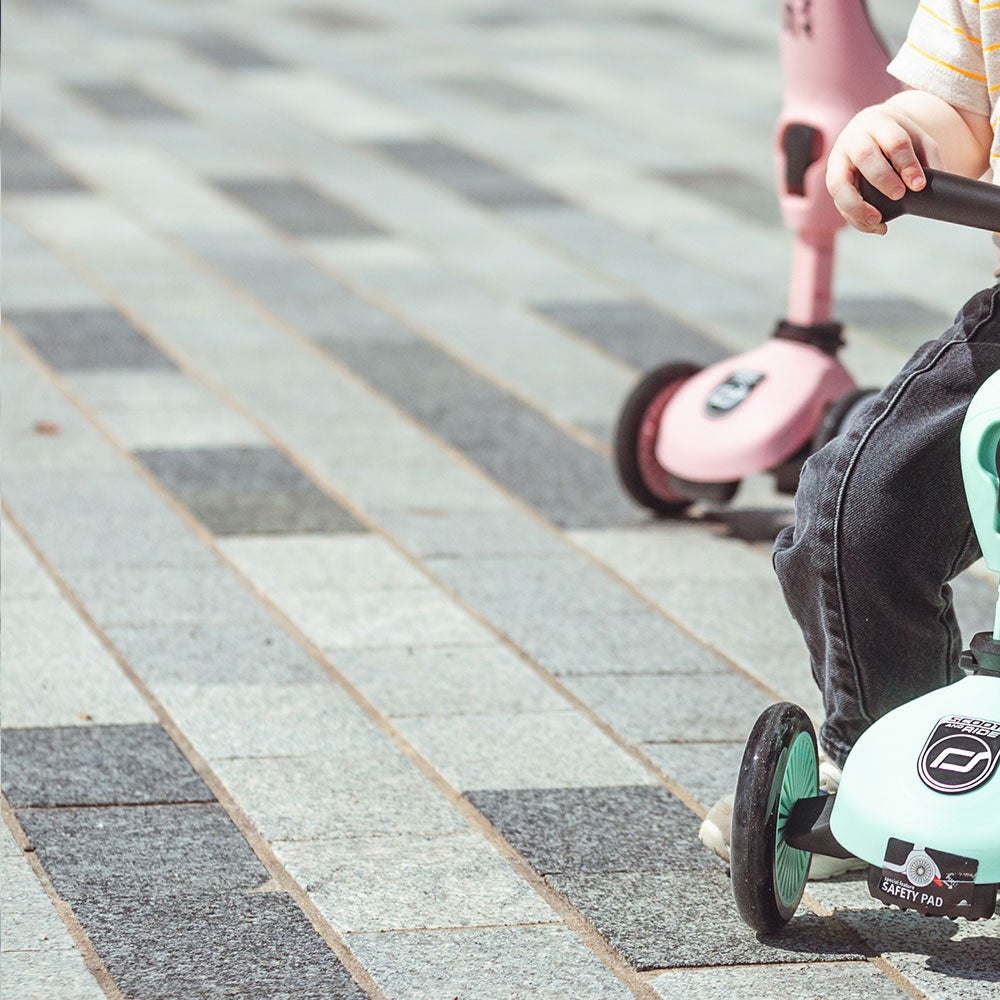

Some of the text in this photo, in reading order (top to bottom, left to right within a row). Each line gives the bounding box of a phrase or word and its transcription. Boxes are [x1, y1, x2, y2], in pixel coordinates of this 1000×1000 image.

[961, 726, 1000, 739] RIDE
[881, 881, 943, 908] SAFETY PAD
